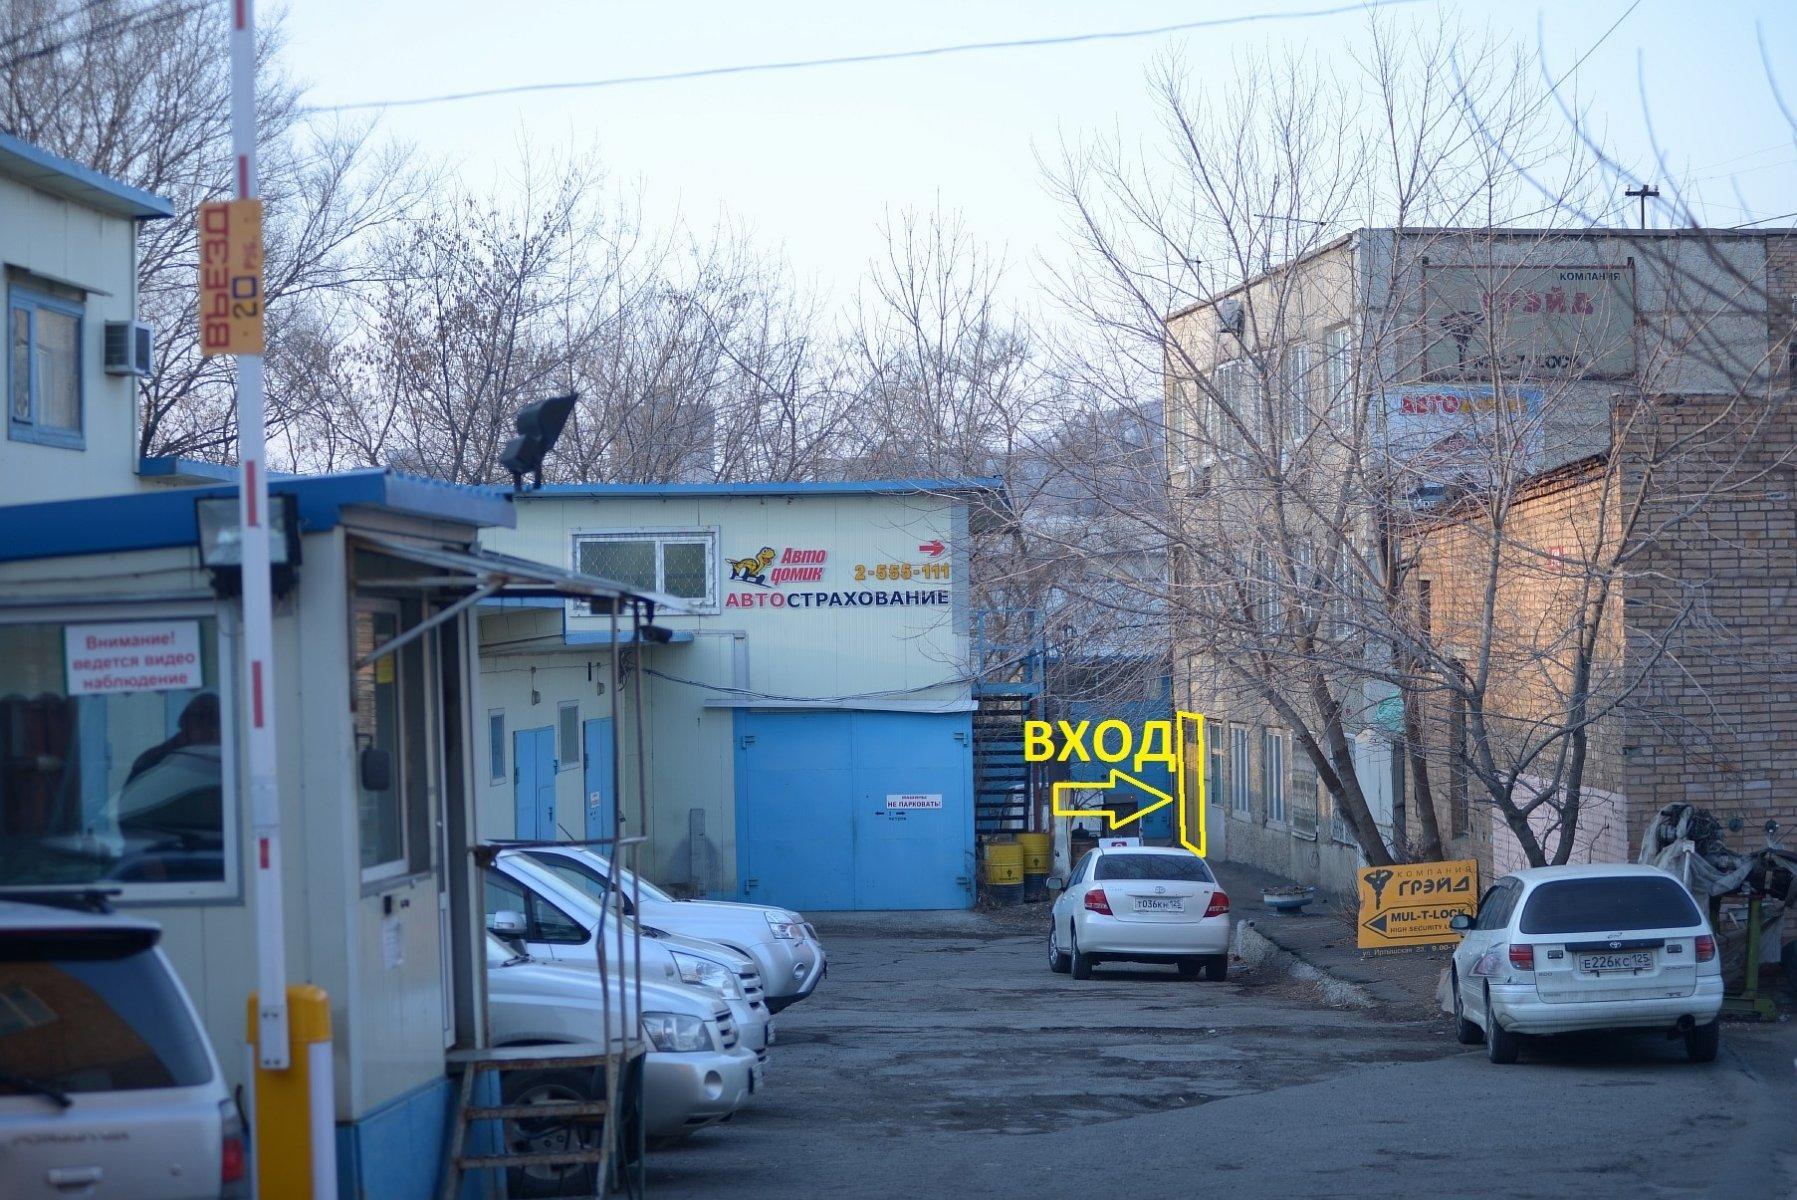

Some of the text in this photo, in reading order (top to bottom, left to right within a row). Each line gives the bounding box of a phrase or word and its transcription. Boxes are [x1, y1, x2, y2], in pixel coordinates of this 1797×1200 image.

[1559, 272, 1620, 282] КОМПАНИЯ
[231, 275, 259, 319] 20
[780, 546, 828, 565] Авто
[770, 566, 825, 586] домик
[854, 563, 951, 582] 2-555-111
[725, 590, 950, 608] АВТОСТРАХОВАНИЕ
[85, 630, 176, 651] Внимание!
[72, 652, 196, 671] ведется видео
[83, 673, 188, 690] наблюдение
[1397, 866, 1473, 878] КОМПАНИЯ
[1390, 926, 1408, 934] HIGH
[1409, 924, 1442, 933] SECURITY
[1583, 956, 1631, 969] Е226КС
